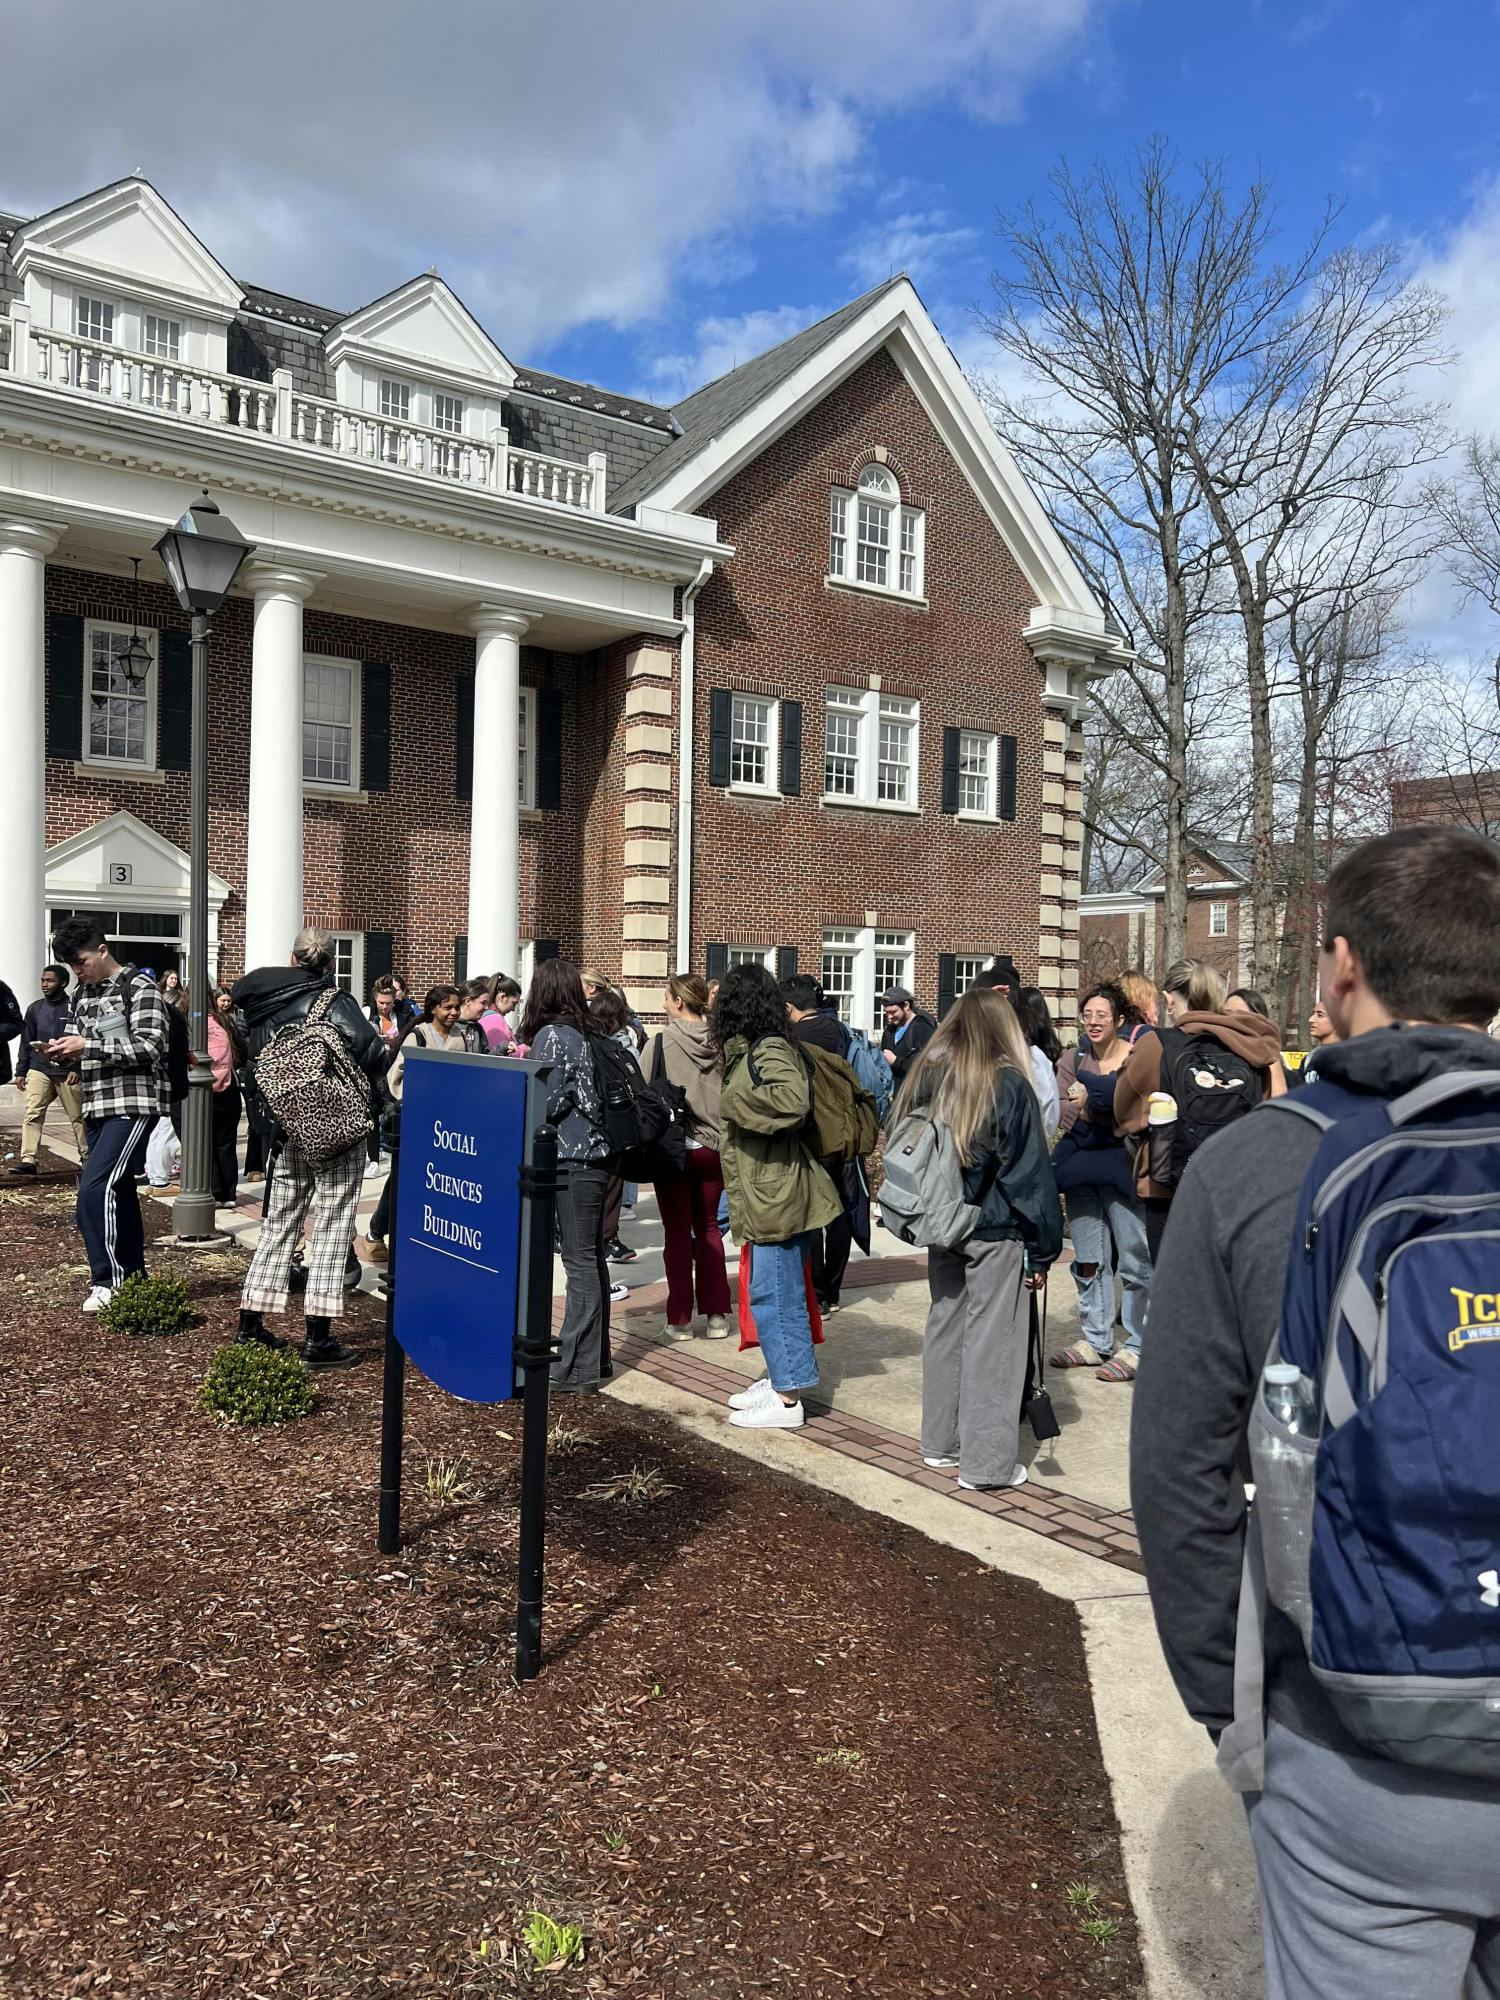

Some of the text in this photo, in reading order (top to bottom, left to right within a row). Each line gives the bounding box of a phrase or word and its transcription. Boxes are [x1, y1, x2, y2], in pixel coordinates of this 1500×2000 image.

[116, 866, 126, 881] 3
[434, 1120, 477, 1156] SOCIAL
[425, 1161, 482, 1204] SCIENCES
[423, 1204, 482, 1251] BUILDING
